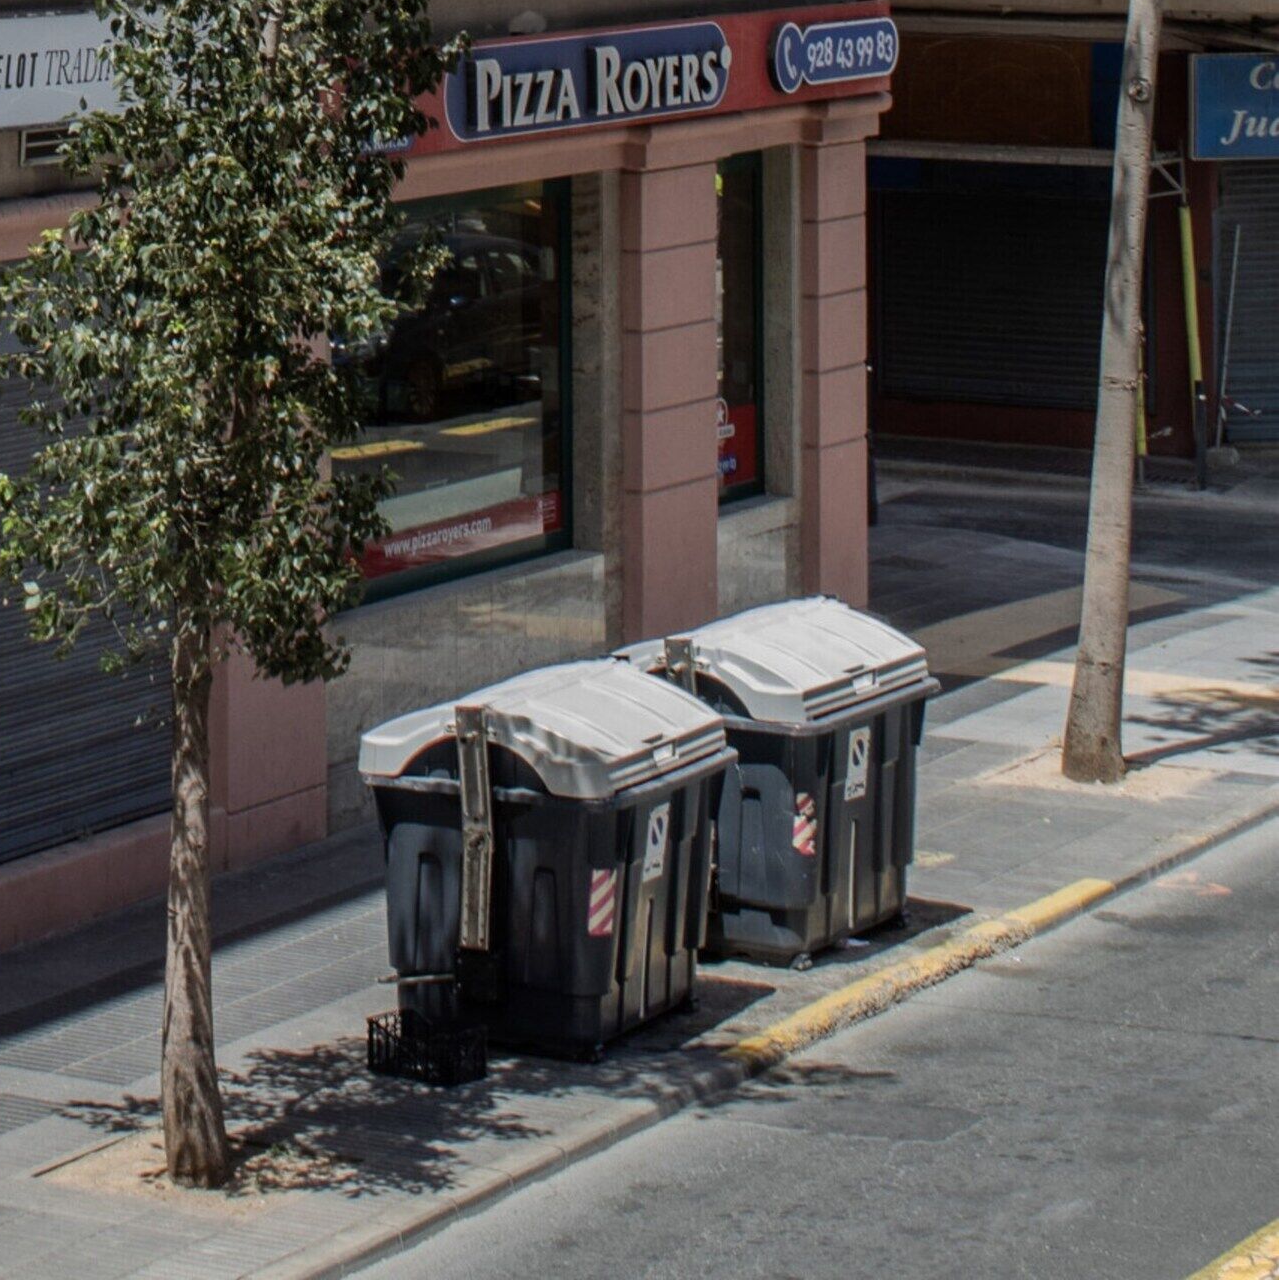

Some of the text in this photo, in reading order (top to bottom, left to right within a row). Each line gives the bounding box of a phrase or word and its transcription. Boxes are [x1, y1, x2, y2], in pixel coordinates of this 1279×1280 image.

[45, 46, 113, 86] TRADI
[807, 30, 893, 73] 928 43 99 83
[476, 45, 719, 132] PIZZA ROYERS
[1249, 60, 1279, 90] C
[383, 516, 492, 559] www.pizzaroyers.com
